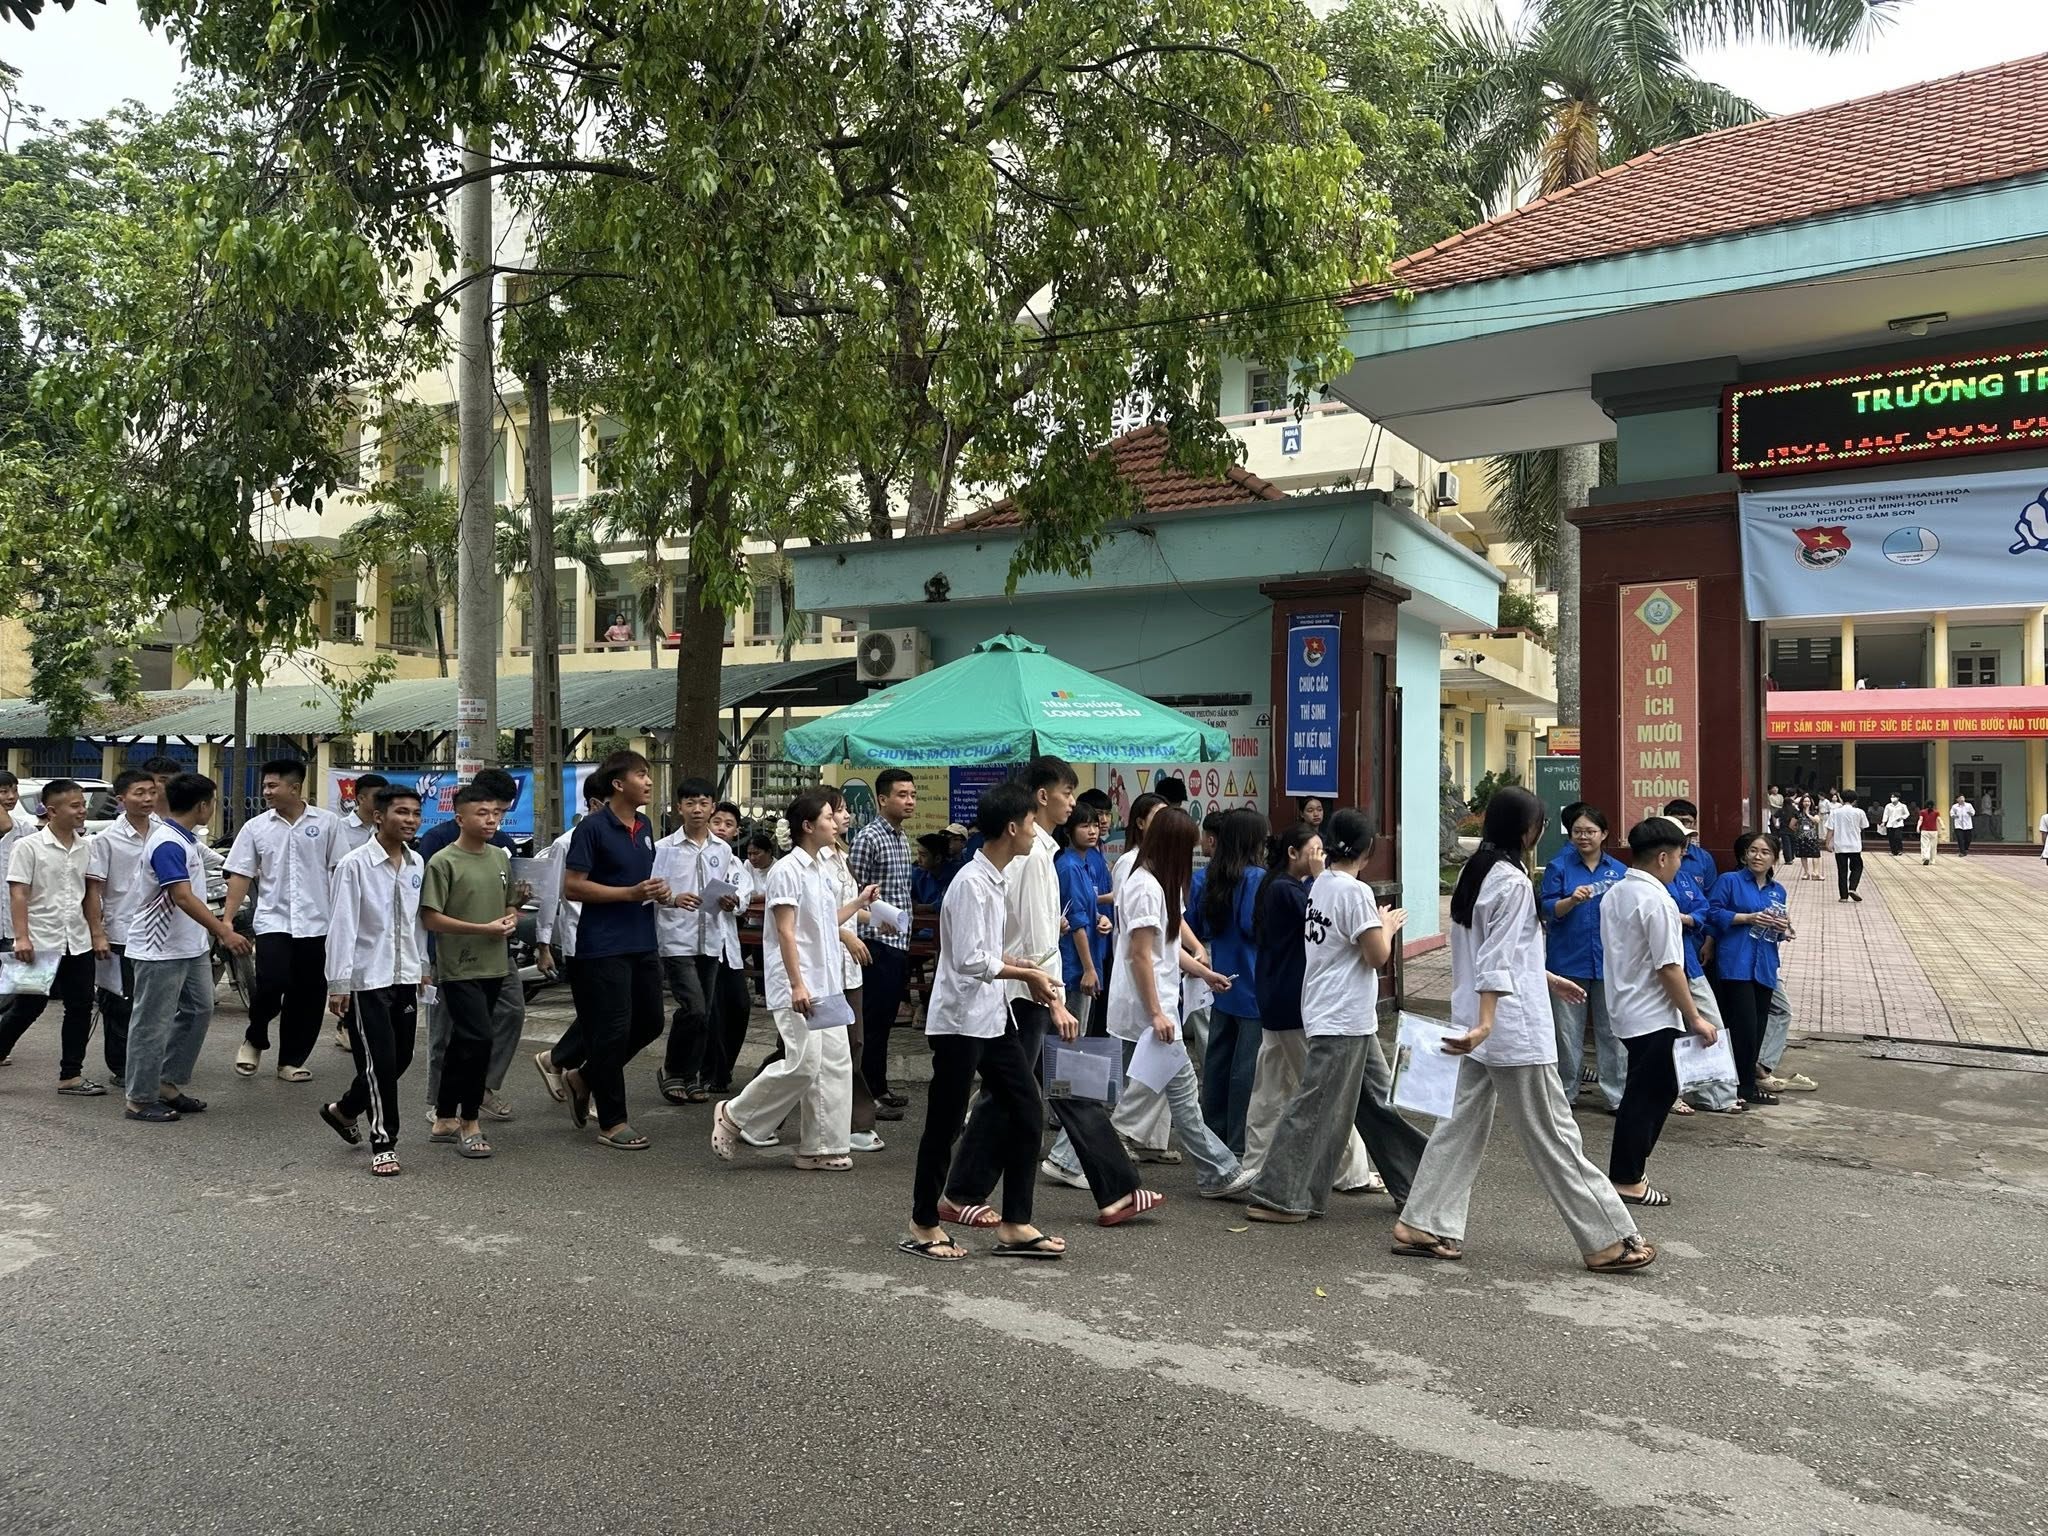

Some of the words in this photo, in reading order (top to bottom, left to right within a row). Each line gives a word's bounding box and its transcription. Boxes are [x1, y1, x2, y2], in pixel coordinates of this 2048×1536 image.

[1852, 373, 2004, 413] TRƯỜNG
[1285, 438, 1298, 451] A
[1778, 510, 1807, 519] ĐOÀN
[1810, 508, 1837, 516] TNCS
[1857, 503, 1876, 512] CHÍ
[1930, 496, 1959, 505] LHTN
[1791, 501, 1820, 511] ĐOÀN
[1829, 498, 1847, 508] HỘI
[1849, 496, 1876, 505] LHTN
[1906, 491, 1943, 500] THANH
[1949, 488, 1970, 497] HÓA
[1817, 513, 1863, 524] PHƯỜNG
[1891, 509, 1915, 518] SƠN
[1651, 639, 1667, 661] VÌ
[1299, 673, 1315, 692] CHÚC
[1316, 672, 1329, 691] CÁC
[1646, 667, 1672, 689] LỢI
[1042, 709, 1091, 717] LONG
[1300, 701, 1311, 720] THÍ
[1311, 704, 1326, 720] SINH
[1645, 695, 1674, 715] ÍCH
[1637, 721, 1682, 743] MƯỜI
[1771, 721, 1791, 733] THPT
[1815, 719, 1833, 732] SƠN
[1841, 719, 1856, 732] NƠI
[1859, 716, 1877, 732] TIẾP
[1880, 716, 1897, 731] SỨC
[1915, 717, 1933, 731] CÁC
[1935, 719, 1949, 731] EM
[1953, 717, 1977, 731] VỮNG
[1981, 716, 2005, 731] BƯỚC
[2007, 716, 2025, 731] VÀO
[2028, 717, 2048, 731] TƯƠ
[1294, 732, 1306, 751] ĐẠT
[1306, 727, 1318, 748] KẾT
[1318, 726, 1332, 748] QUẢ
[1298, 754, 1310, 776] TỐT
[1310, 754, 1326, 776] NHẤT
[1640, 748, 1680, 769] NĂM
[1559, 778, 1580, 792] KHÔ
[1632, 774, 1690, 797] TRỒNG
[1643, 804, 1666, 820] CÂ
